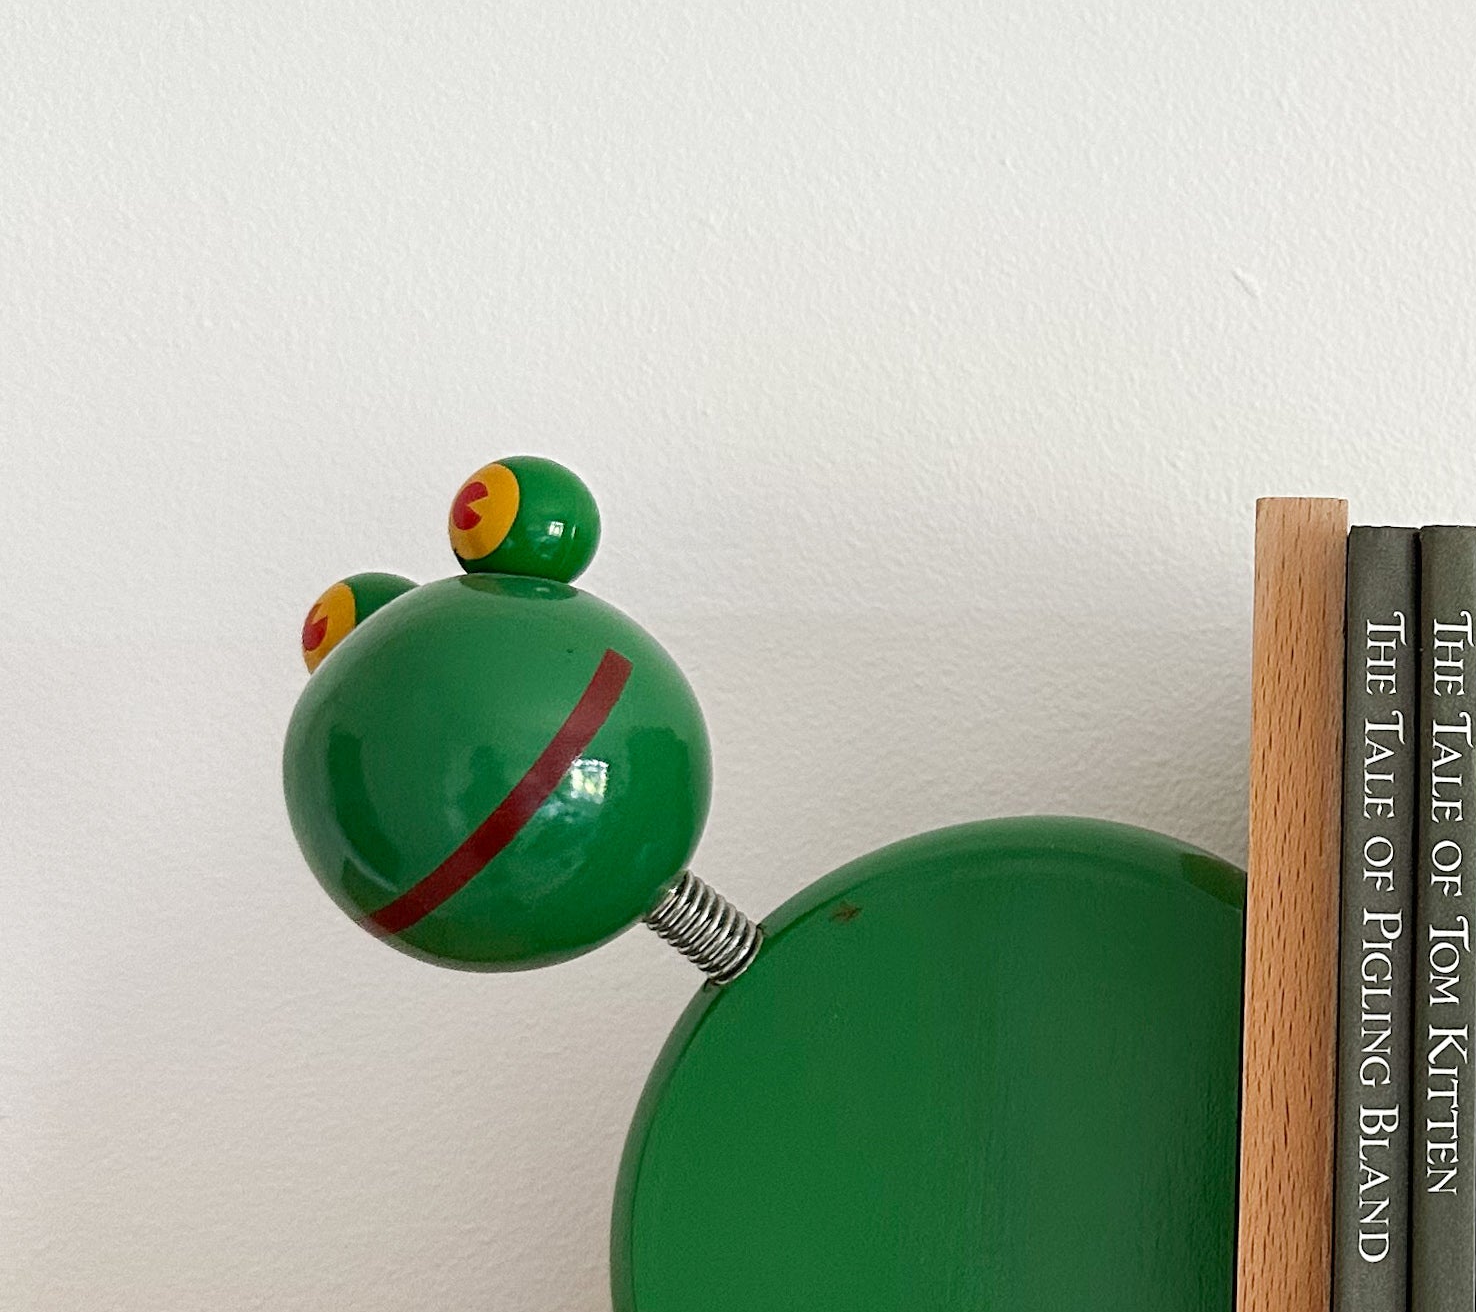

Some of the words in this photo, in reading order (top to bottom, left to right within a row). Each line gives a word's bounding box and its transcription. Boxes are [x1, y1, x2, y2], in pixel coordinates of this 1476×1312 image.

[1366, 611, 1407, 695] THE
[1433, 610, 1475, 697] THE
[1363, 710, 1405, 820] TALE
[1431, 711, 1474, 823] TALE
[1362, 836, 1395, 892] OF
[1430, 840, 1463, 897] OF
[1359, 907, 1403, 1088] PIGLING
[1429, 915, 1471, 1007] TOM
[1426, 1024, 1469, 1196] KITTEN
[1358, 1104, 1399, 1263] BLAND
